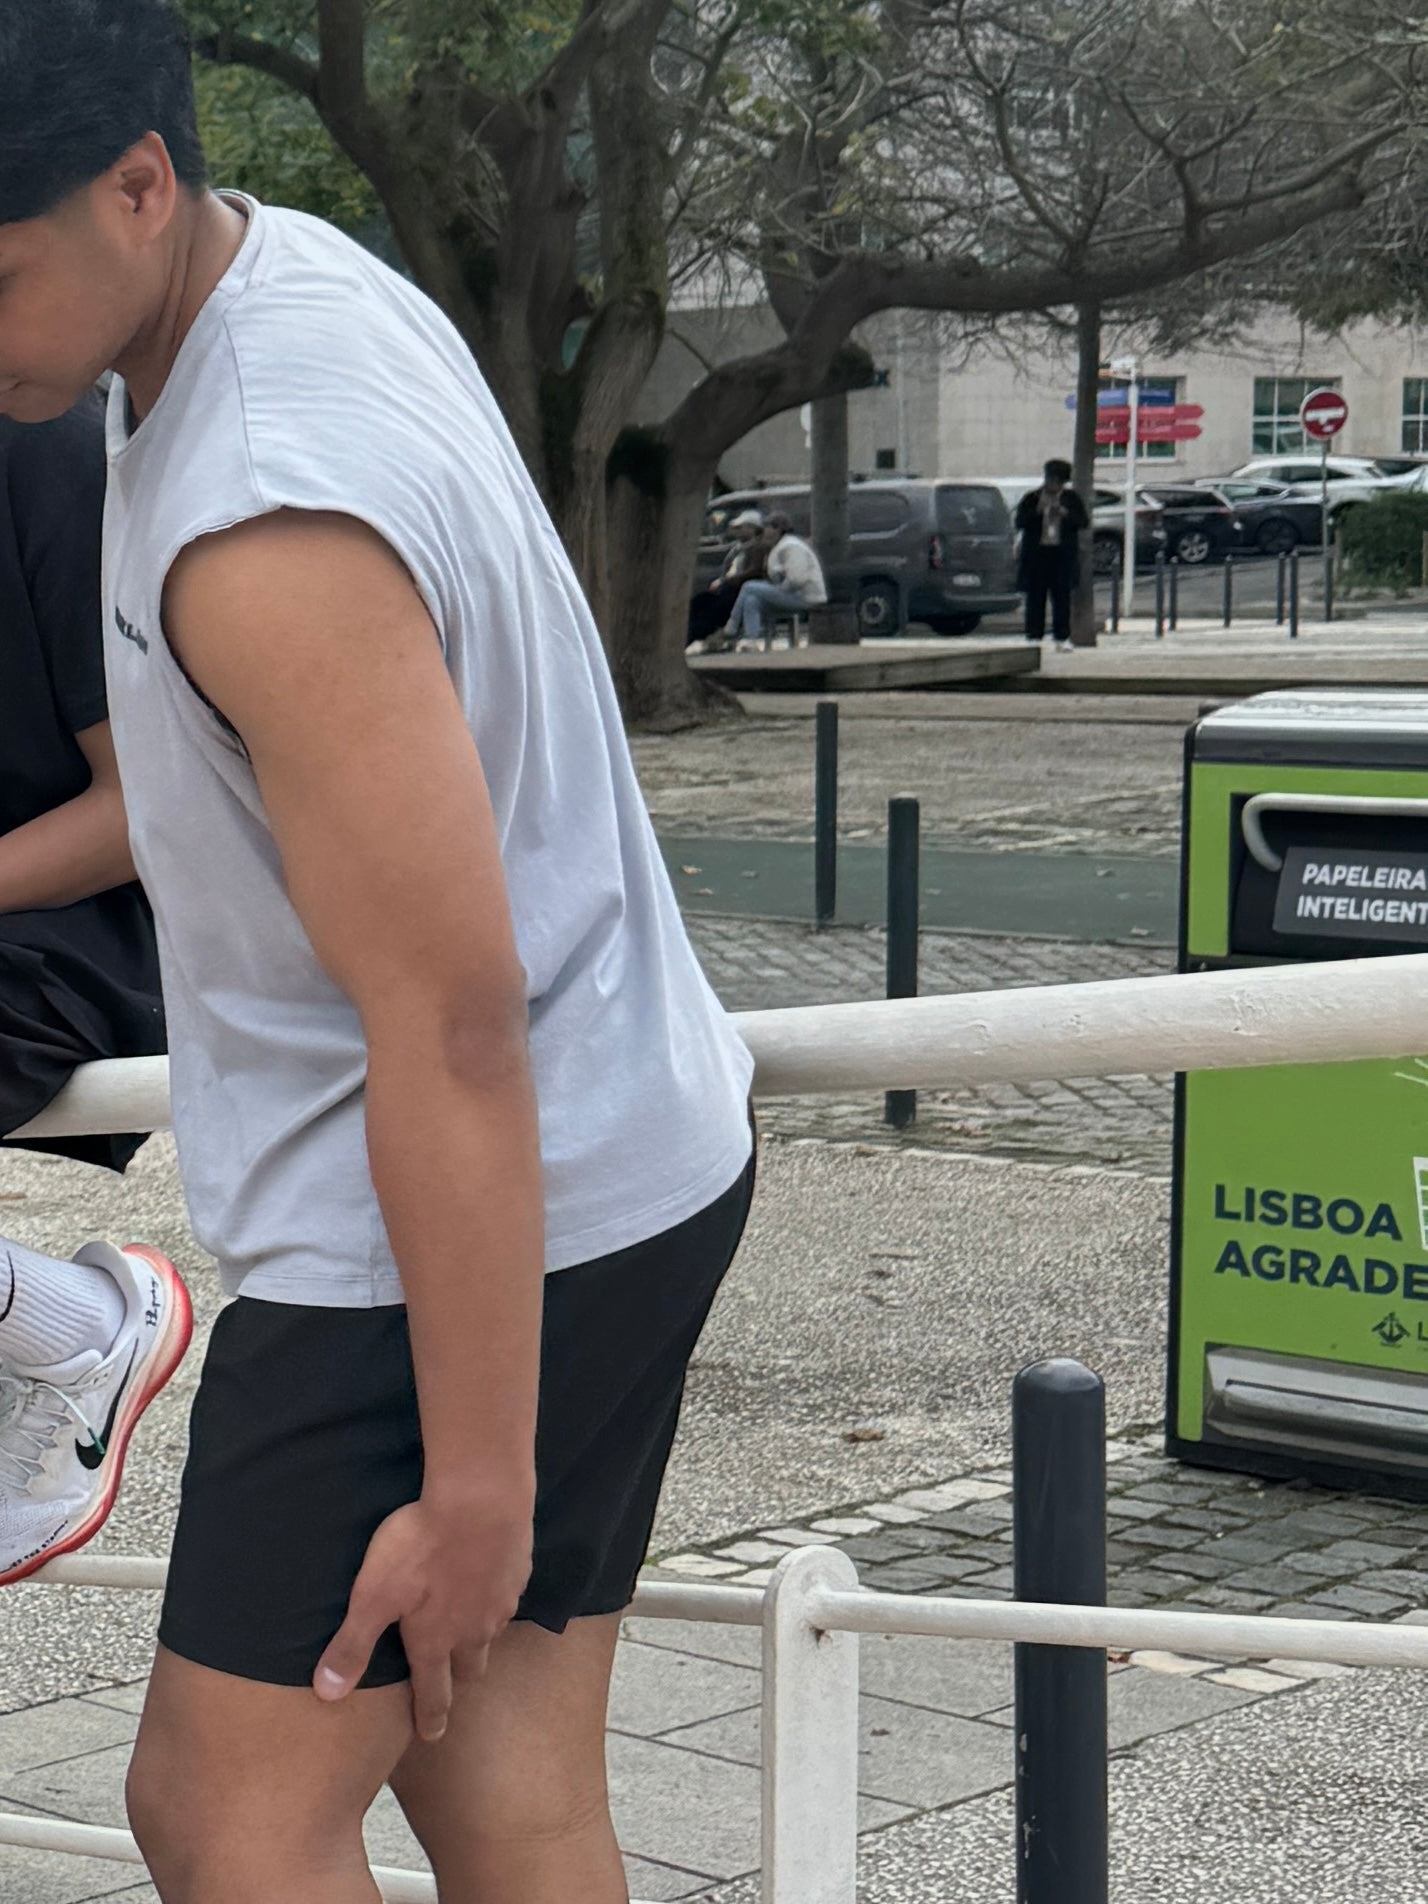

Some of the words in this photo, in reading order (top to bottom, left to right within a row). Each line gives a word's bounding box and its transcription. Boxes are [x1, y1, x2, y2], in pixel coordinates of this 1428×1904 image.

[1302, 863, 1427, 891] PAPELEIRA
[1296, 894, 1428, 925] INTELIGENT
[1215, 1184, 1403, 1241] LISBOA
[1214, 1240, 1428, 1302] AGRADE
